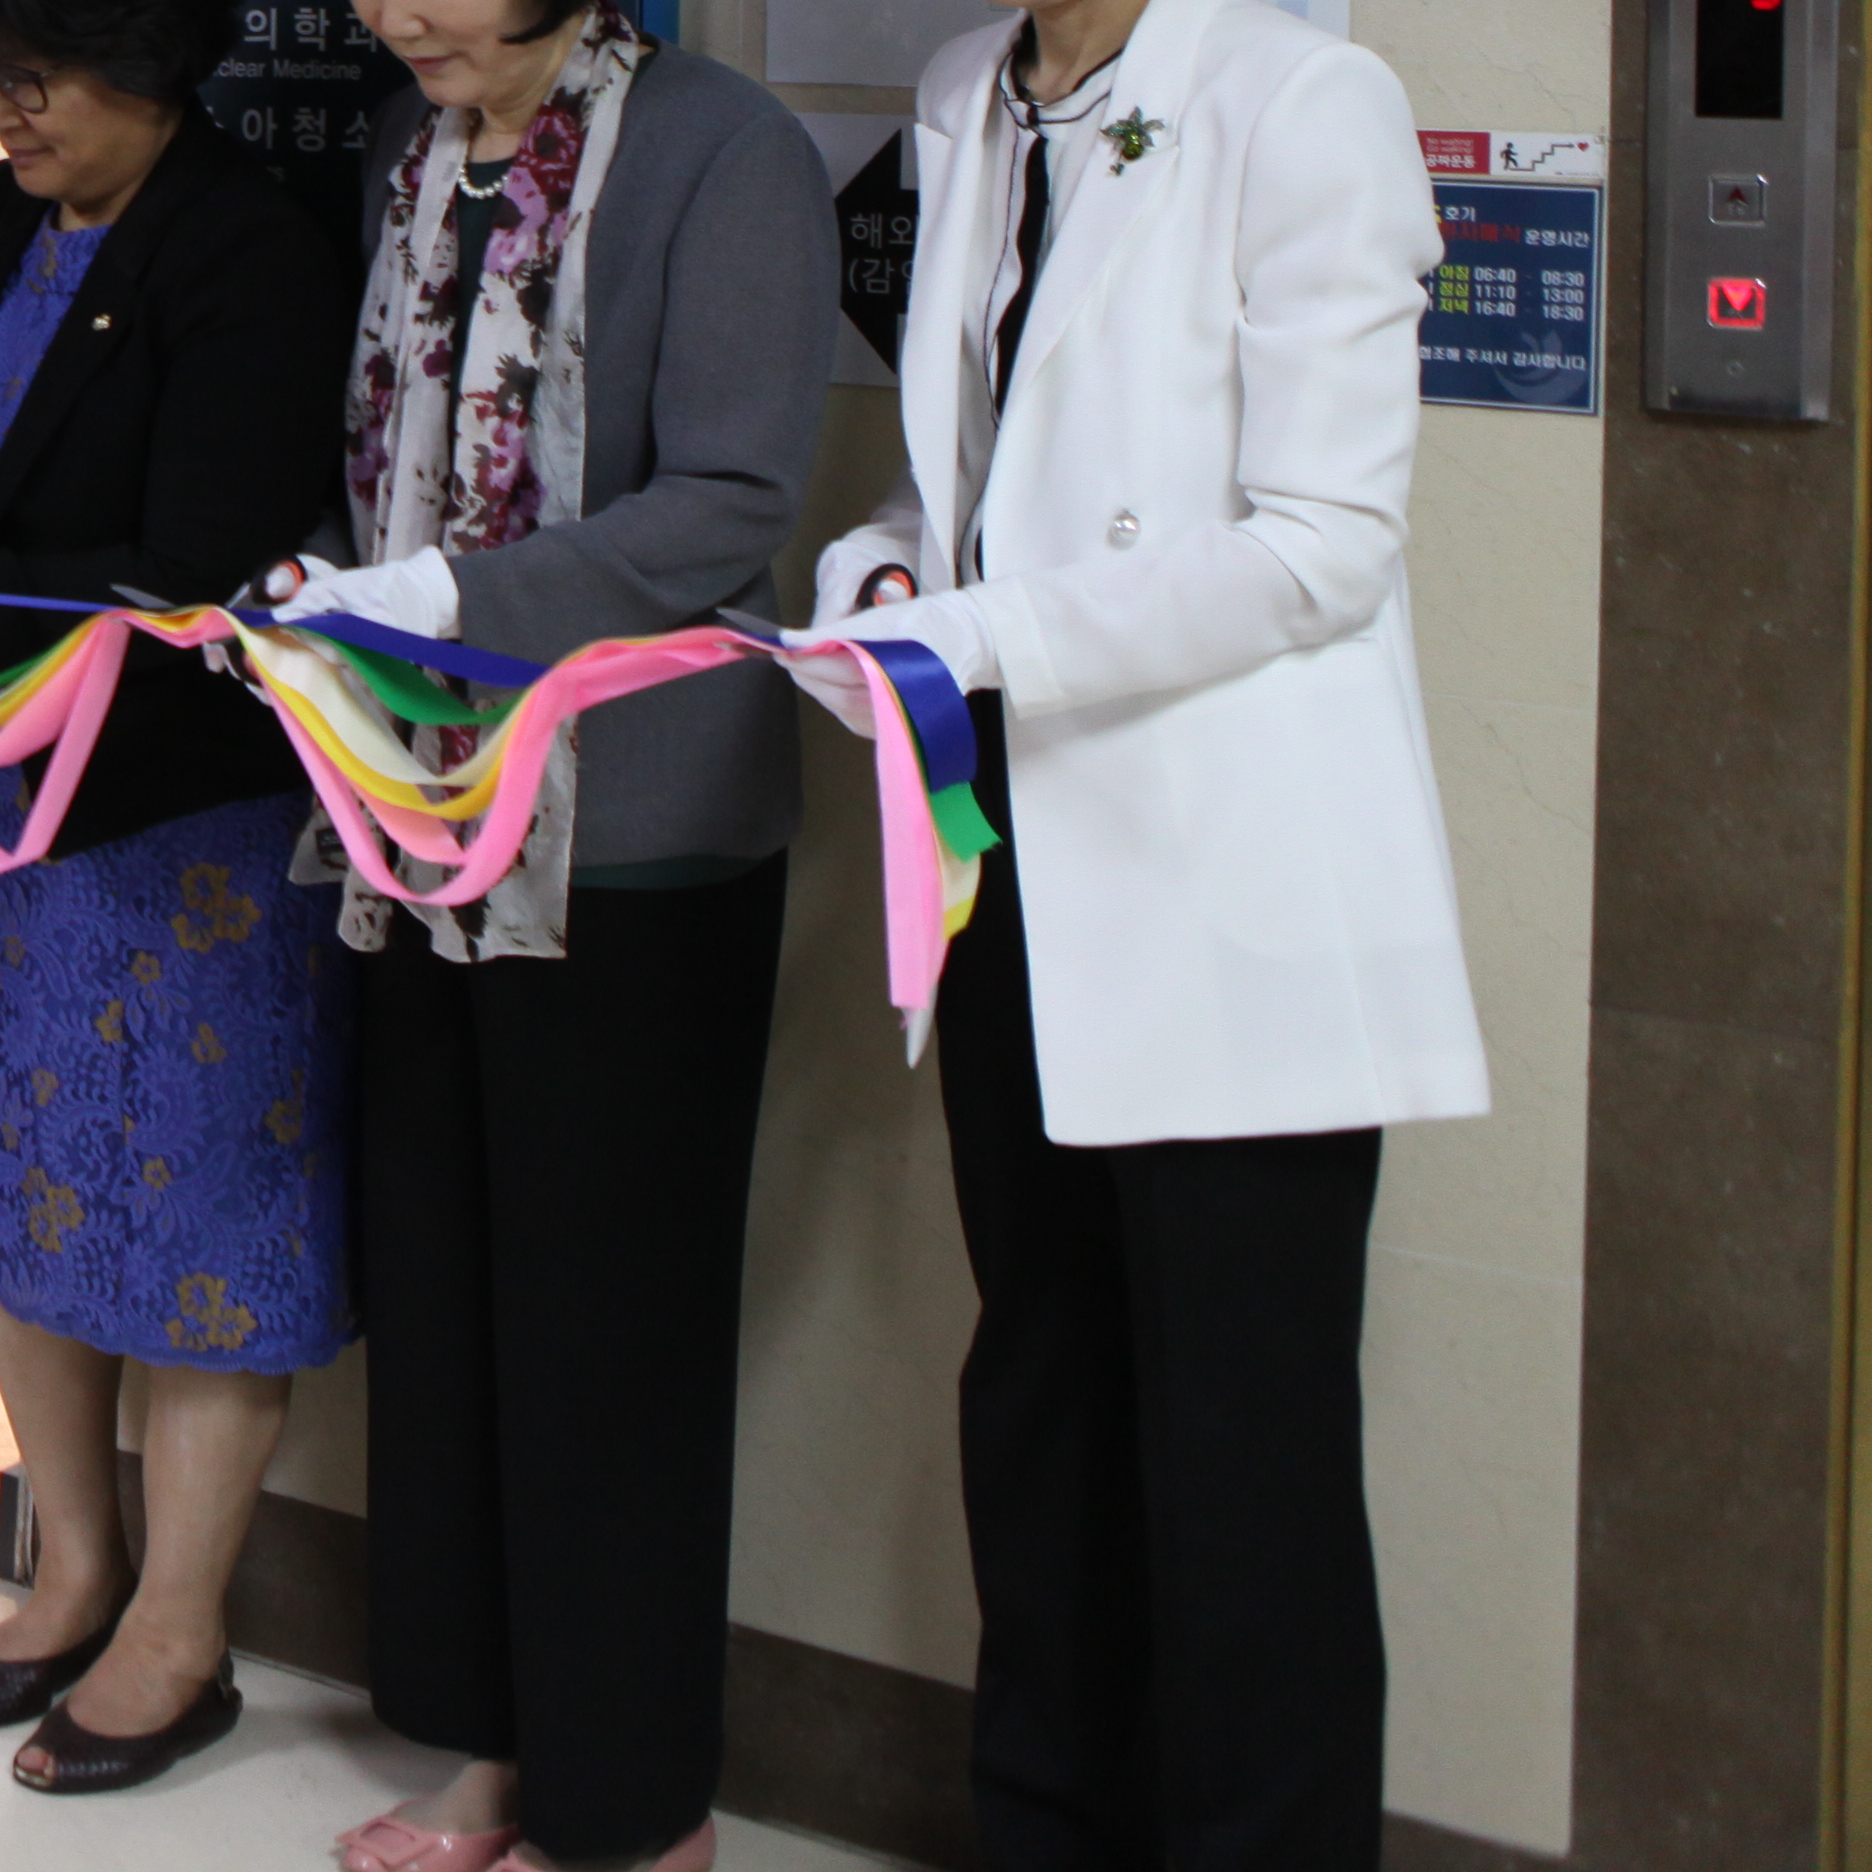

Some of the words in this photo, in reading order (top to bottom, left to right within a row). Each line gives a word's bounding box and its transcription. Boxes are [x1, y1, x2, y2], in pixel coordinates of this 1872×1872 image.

[273, 58, 362, 80] Medicine
[1473, 266, 1516, 284] 06:40
[1475, 283, 1516, 300] 11:10
[1542, 287, 1585, 304] 13:00
[1475, 300, 1516, 317] 16:40
